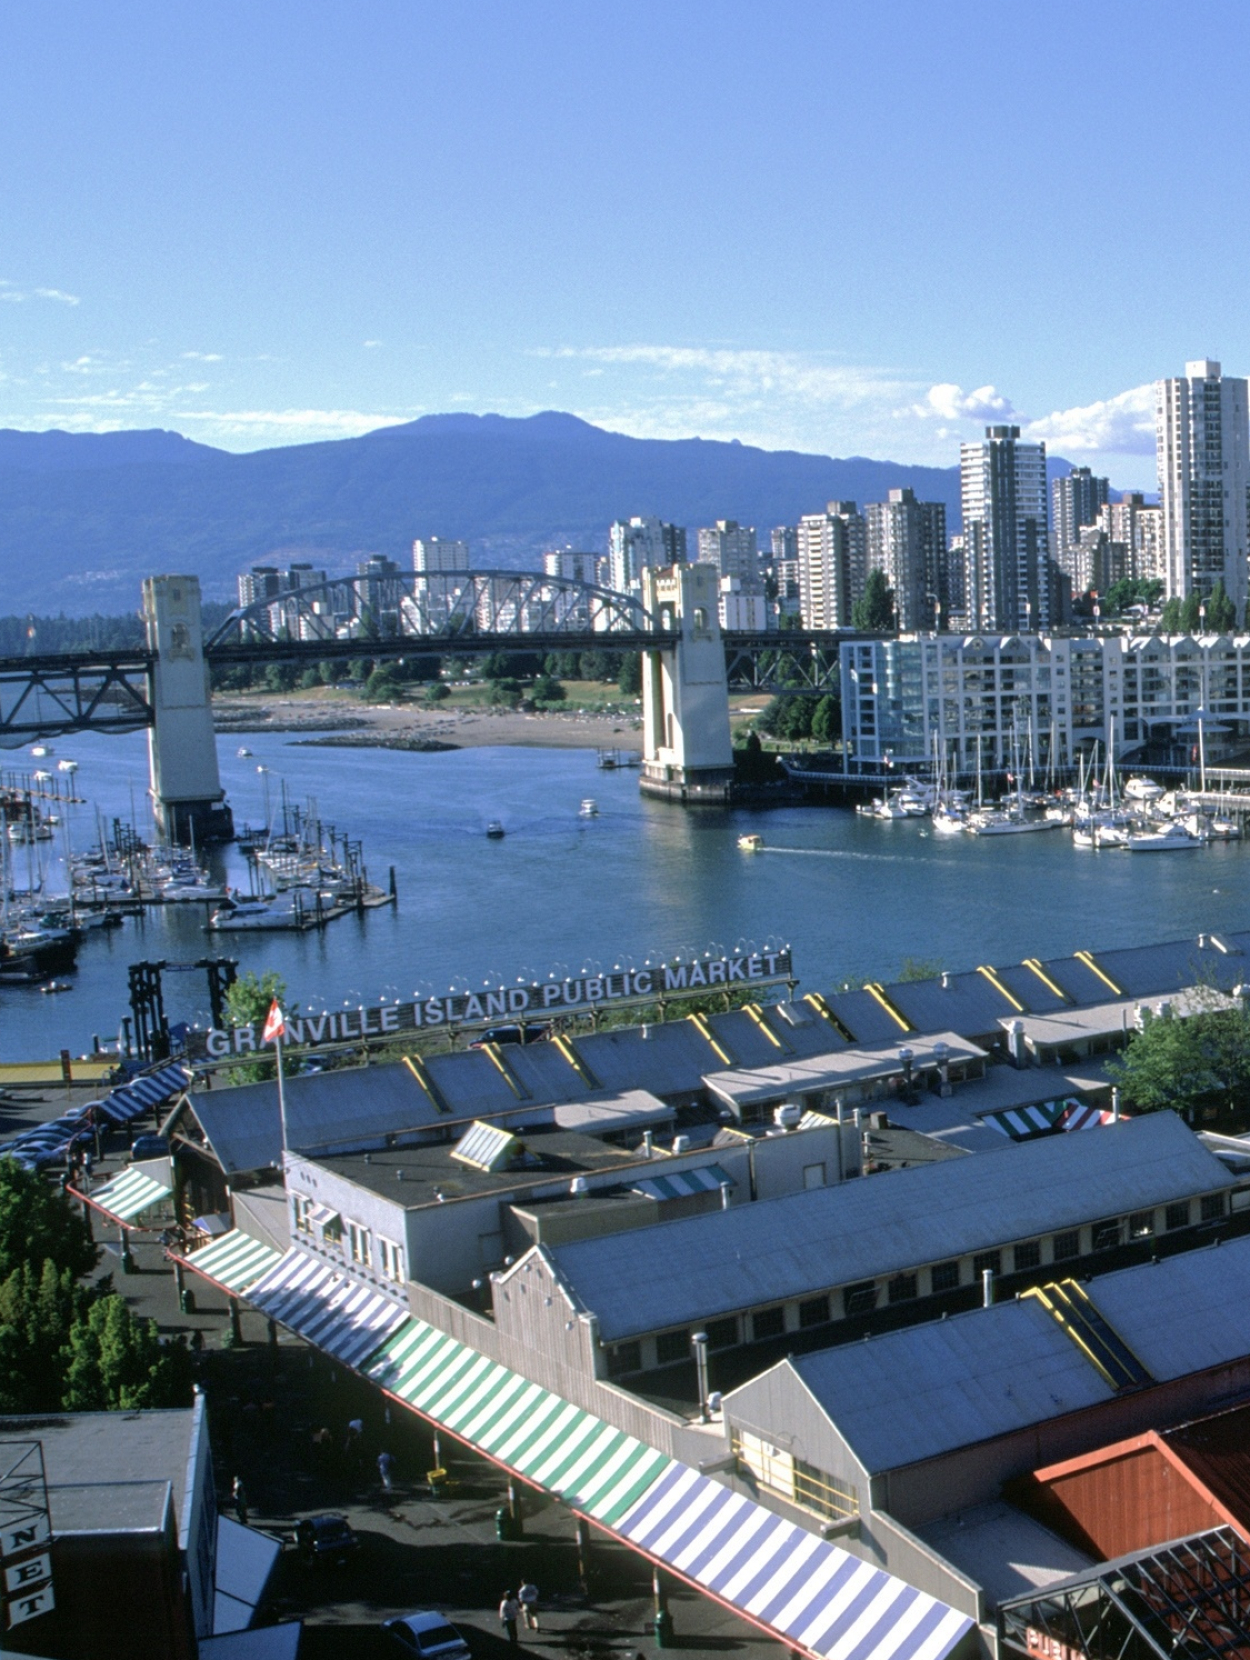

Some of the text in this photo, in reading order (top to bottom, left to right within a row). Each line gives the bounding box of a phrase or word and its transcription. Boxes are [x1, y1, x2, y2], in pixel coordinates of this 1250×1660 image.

[414, 988, 529, 1026] ISLAND
[543, 971, 652, 1007] PUBLIC
[664, 953, 780, 990] MARKET
